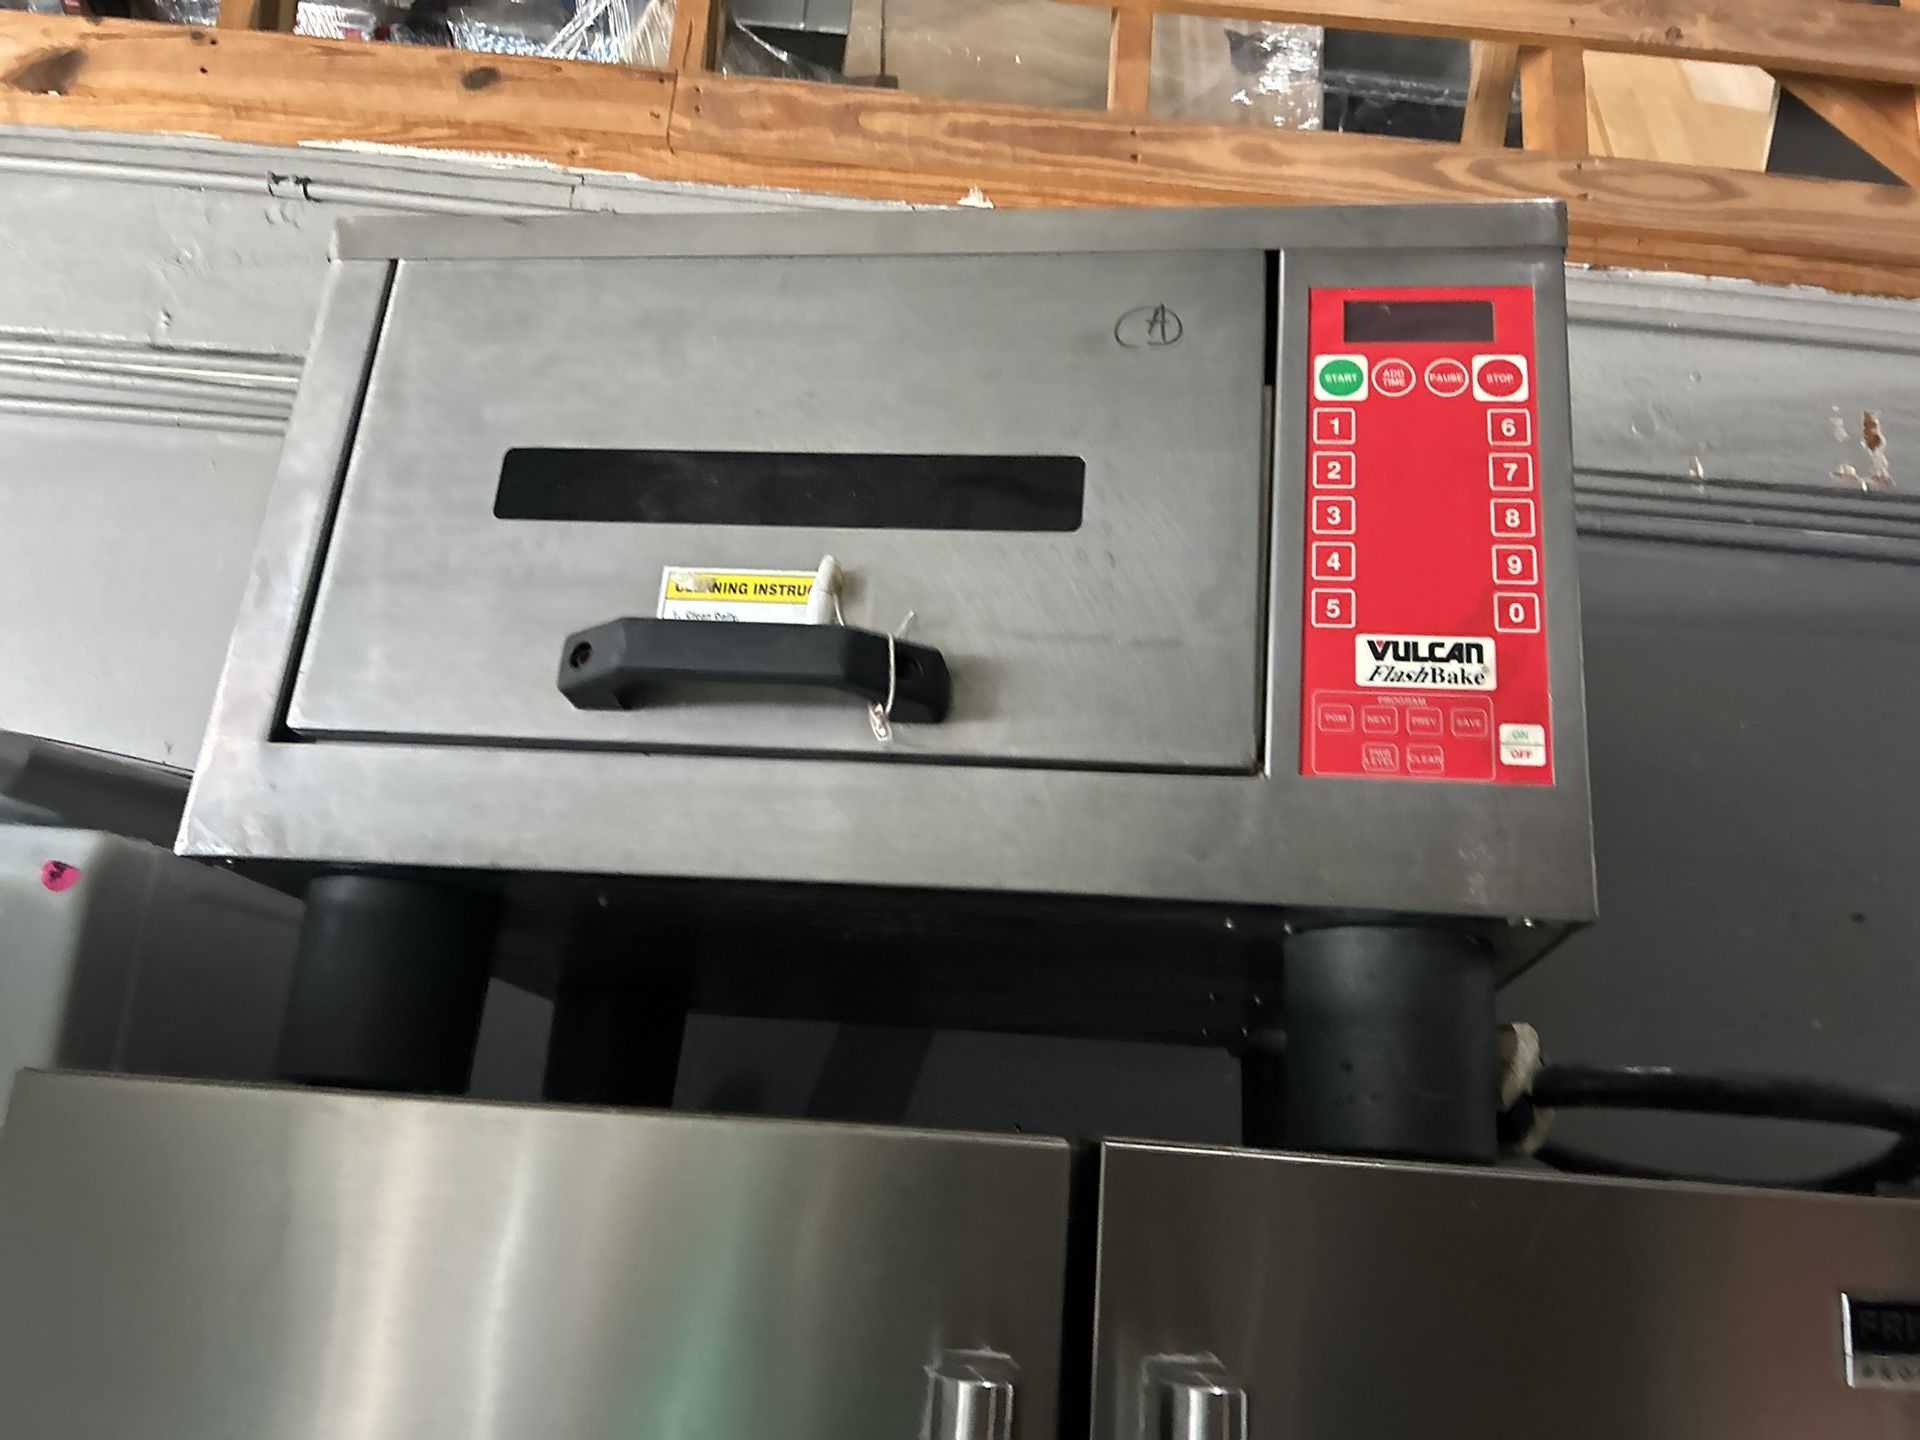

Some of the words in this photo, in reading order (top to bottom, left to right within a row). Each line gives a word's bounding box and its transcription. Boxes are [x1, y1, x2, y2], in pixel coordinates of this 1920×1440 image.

[1324, 373, 1358, 384] START
[1382, 369, 1405, 378] ADD
[1383, 377, 1406, 388] TIME
[1429, 372, 1464, 384] PAUSE
[1486, 373, 1514, 385] STOP
[1329, 417, 1340, 435] 1
[1501, 417, 1516, 437] 6
[1327, 461, 1342, 480] 2
[1503, 462, 1518, 481] 7
[1326, 505, 1341, 525] 3
[1505, 508, 1521, 528] 8
[1326, 551, 1341, 571] 4
[1506, 554, 1523, 575] 9
[1326, 598, 1341, 619] 5
[1508, 602, 1525, 623] 0
[1366, 639, 1484, 664] VULCAN
[1377, 695, 1427, 706] PROGRAM
[1366, 714, 1392, 725] NEXT
[1511, 730, 1530, 740] ON
[1510, 750, 1533, 760] OFF
